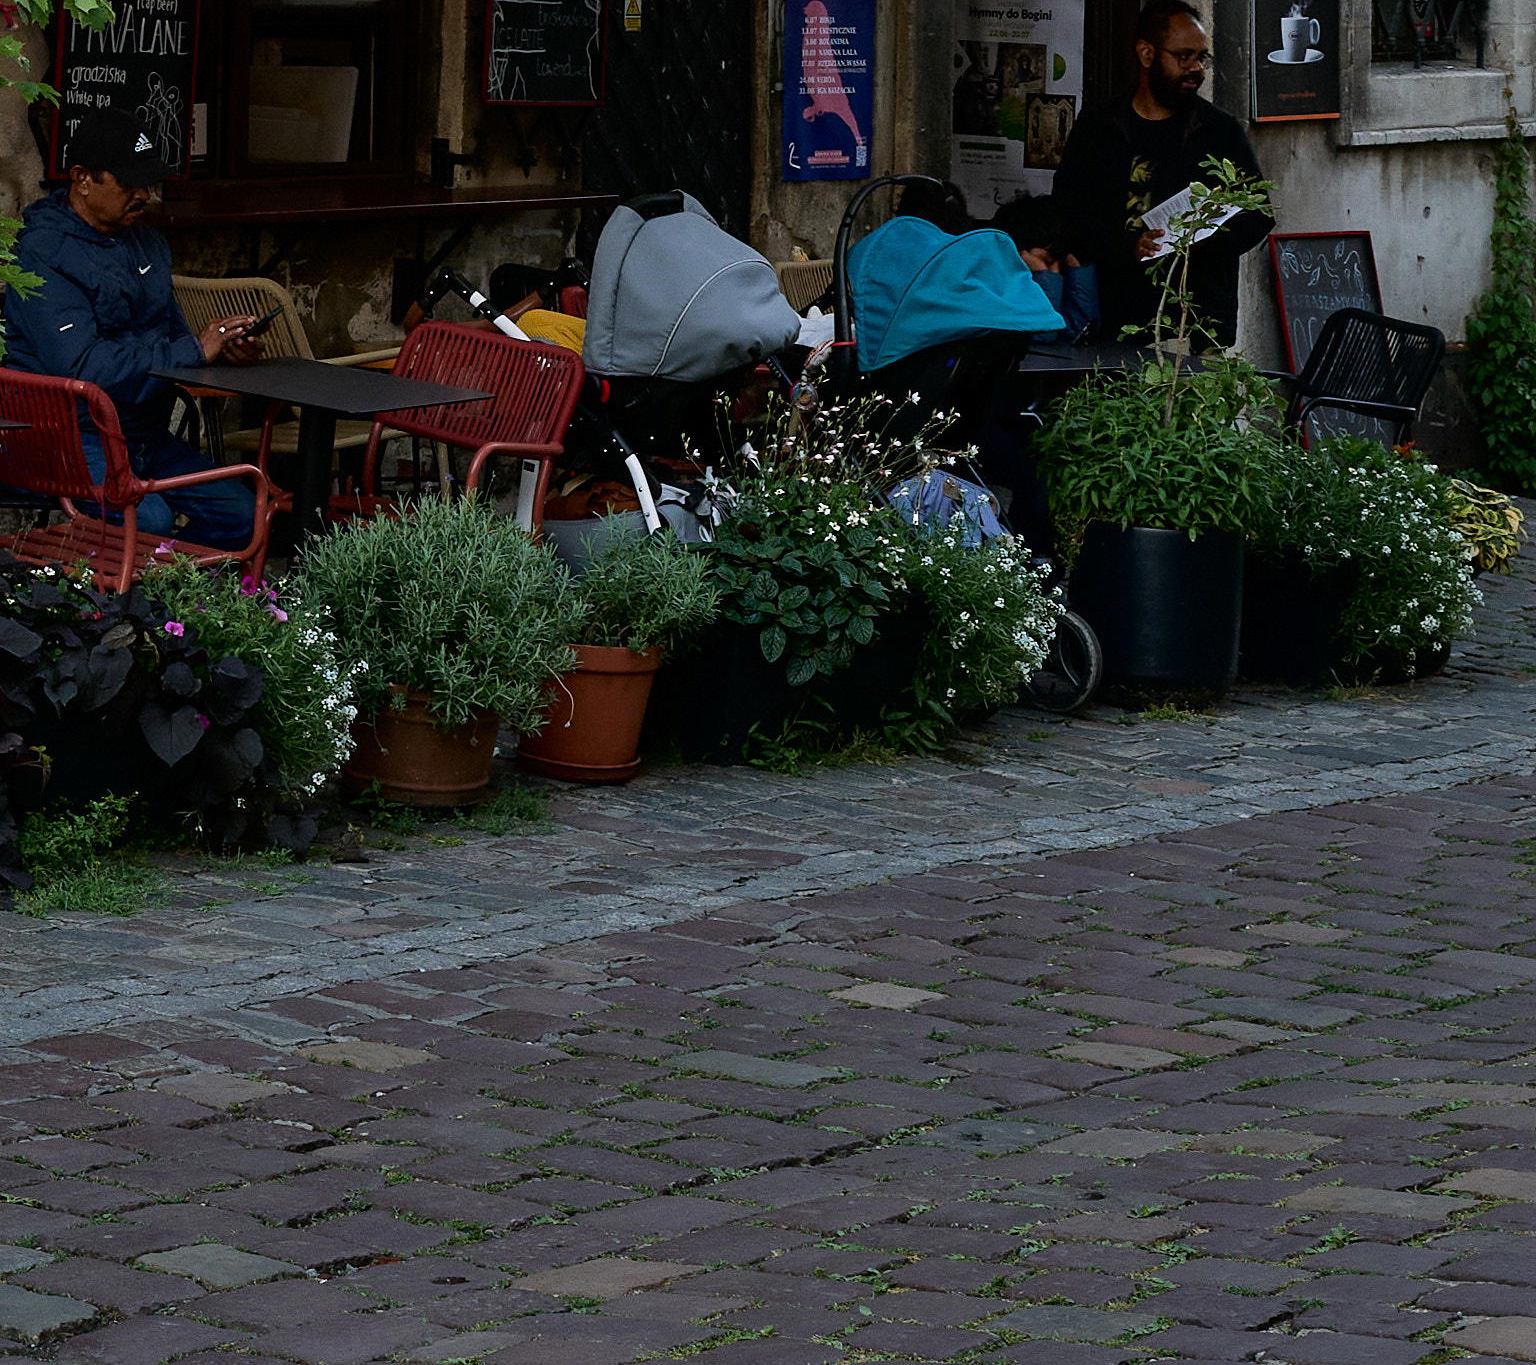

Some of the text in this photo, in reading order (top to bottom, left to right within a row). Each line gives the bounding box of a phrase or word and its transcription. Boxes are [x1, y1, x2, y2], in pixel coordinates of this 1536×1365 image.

[969, 6, 1052, 21] Hymny do Bogini
[139, 17, 191, 56] LANE
